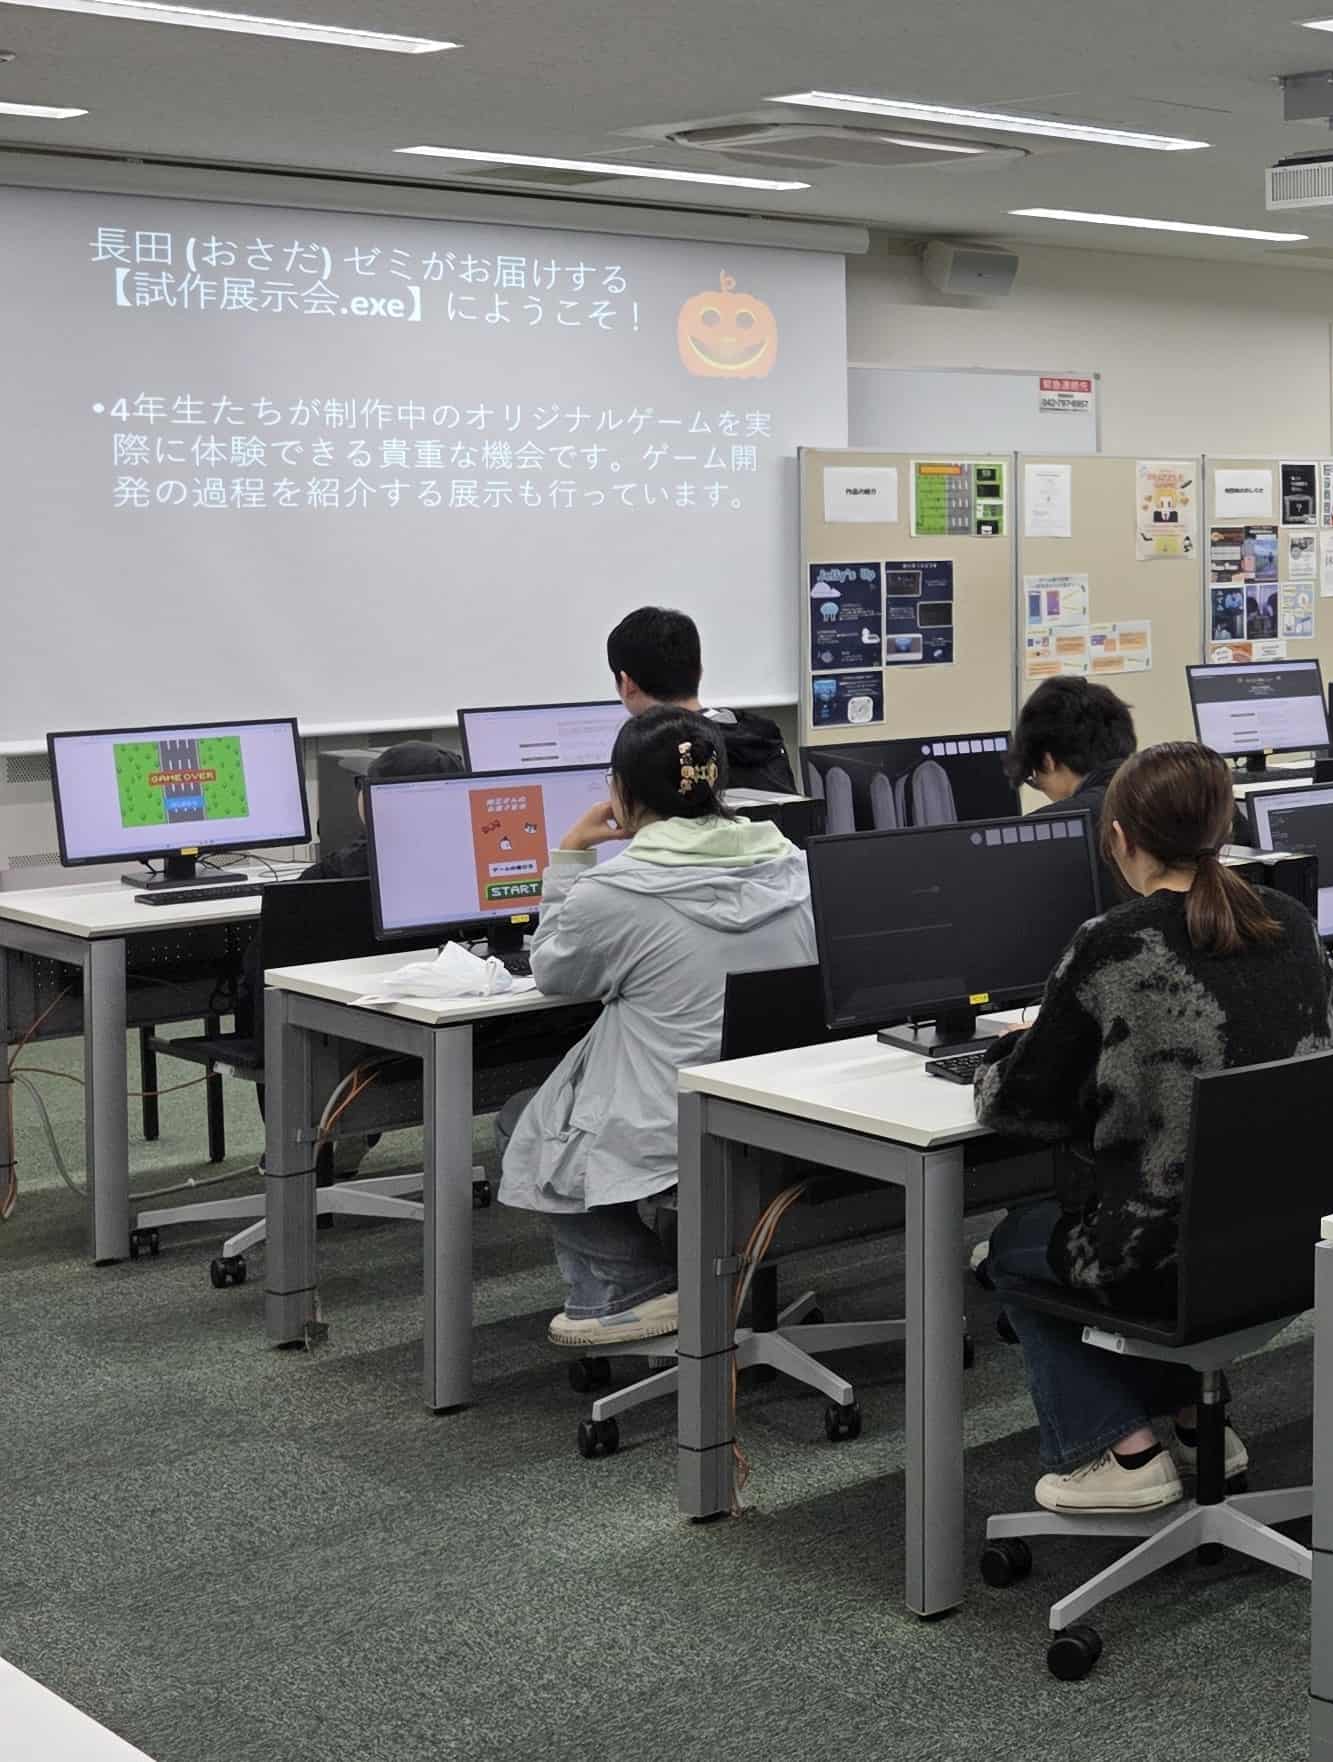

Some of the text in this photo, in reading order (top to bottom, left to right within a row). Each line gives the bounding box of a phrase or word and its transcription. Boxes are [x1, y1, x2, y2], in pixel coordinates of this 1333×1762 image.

[88, 227, 627, 294] 長田 (おさだ) ゼミがお届けする
[113, 475, 746, 509] 発の過程を紹介する展示も行っています。
[150, 770, 214, 784] GAME OVER
[491, 883, 539, 897] START
